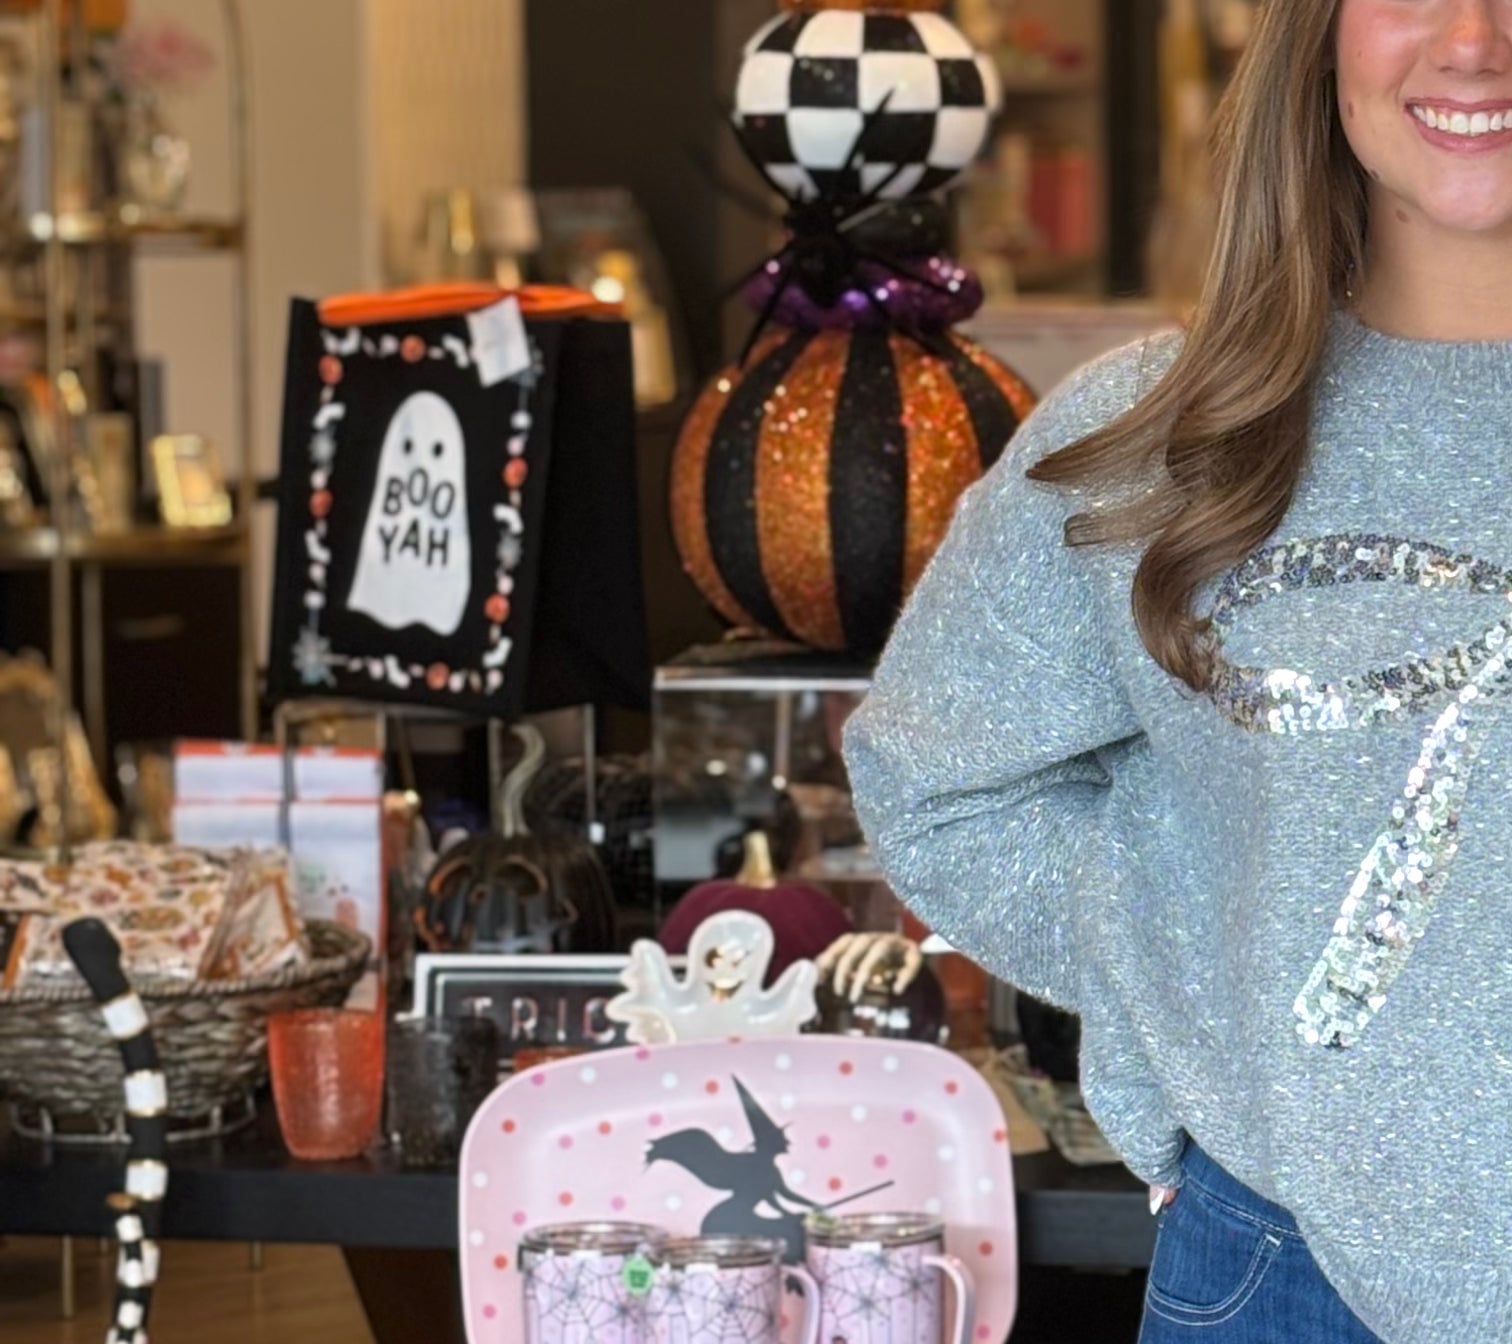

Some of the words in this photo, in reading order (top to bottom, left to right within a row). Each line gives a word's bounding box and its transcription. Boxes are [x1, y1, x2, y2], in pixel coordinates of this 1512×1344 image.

[383, 467, 456, 519] BOO
[378, 517, 450, 567] YAH
[460, 996, 617, 1044] TRIC
